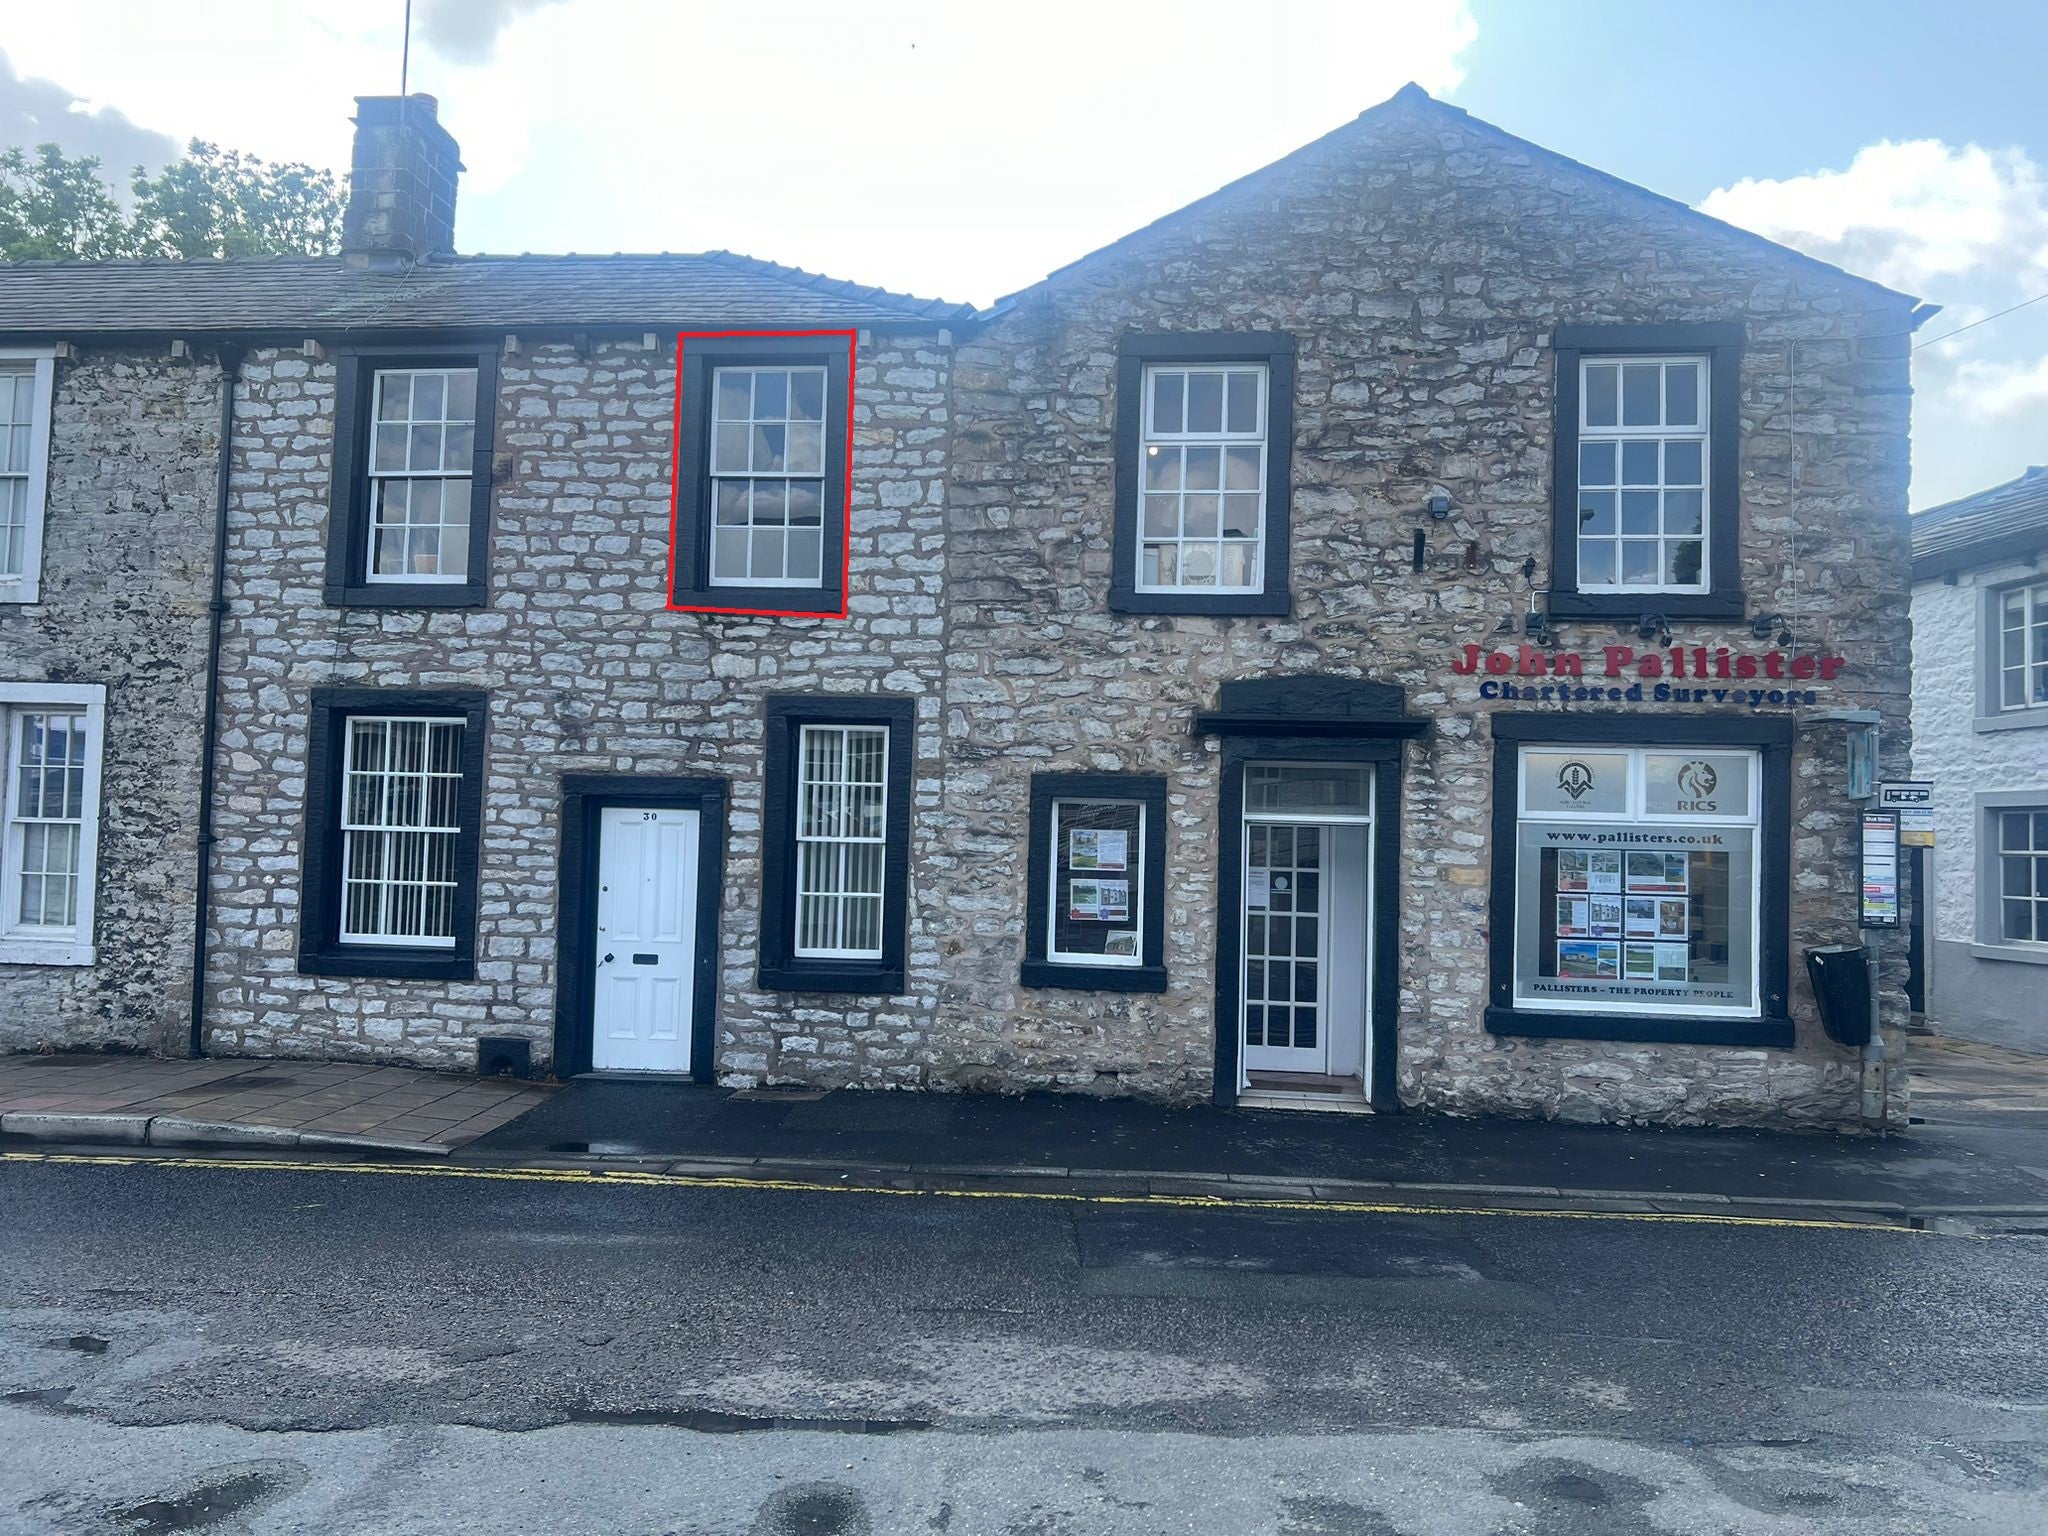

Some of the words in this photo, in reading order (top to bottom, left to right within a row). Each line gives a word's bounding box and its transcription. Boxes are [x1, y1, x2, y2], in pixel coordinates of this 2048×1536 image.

[1452, 643, 1583, 677] John
[1602, 645, 1846, 681] Pallister
[1479, 680, 1642, 701] Chartered
[1653, 682, 1817, 706] Surveyors
[1677, 800, 1717, 812] RICS
[643, 812, 658, 821] 30
[1546, 832, 1723, 845] www.pallisters.co.uk
[1533, 983, 1597, 994] PALLISTERS
[1608, 986, 1631, 995] THE
[1633, 987, 1690, 997] PROPERTY
[1693, 989, 1734, 999] PEOPLE
